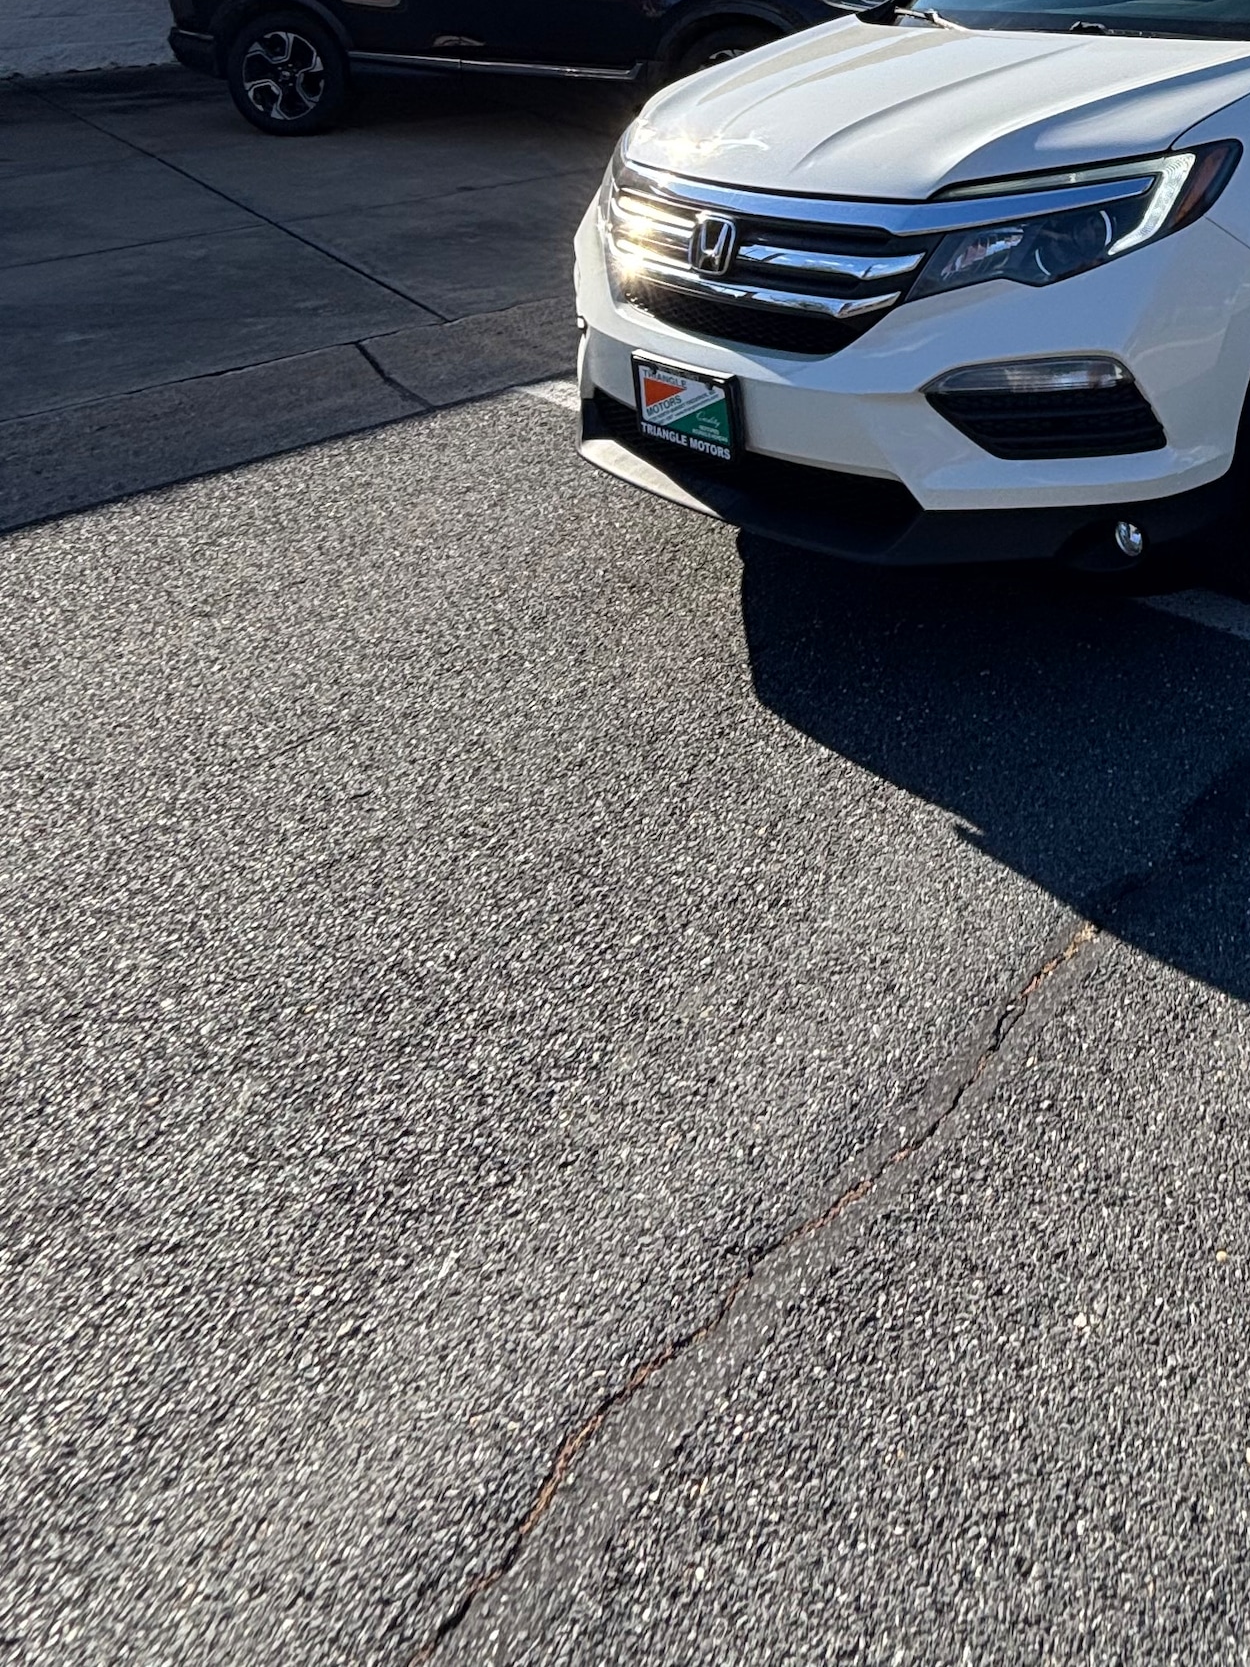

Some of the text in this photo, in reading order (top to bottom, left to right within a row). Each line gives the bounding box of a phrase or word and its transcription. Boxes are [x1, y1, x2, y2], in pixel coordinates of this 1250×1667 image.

[643, 369, 687, 389] TRIANGLE
[646, 395, 682, 416] MOTORS
[641, 422, 688, 446] TRIANGLE
[690, 437, 731, 460] MOTORS
